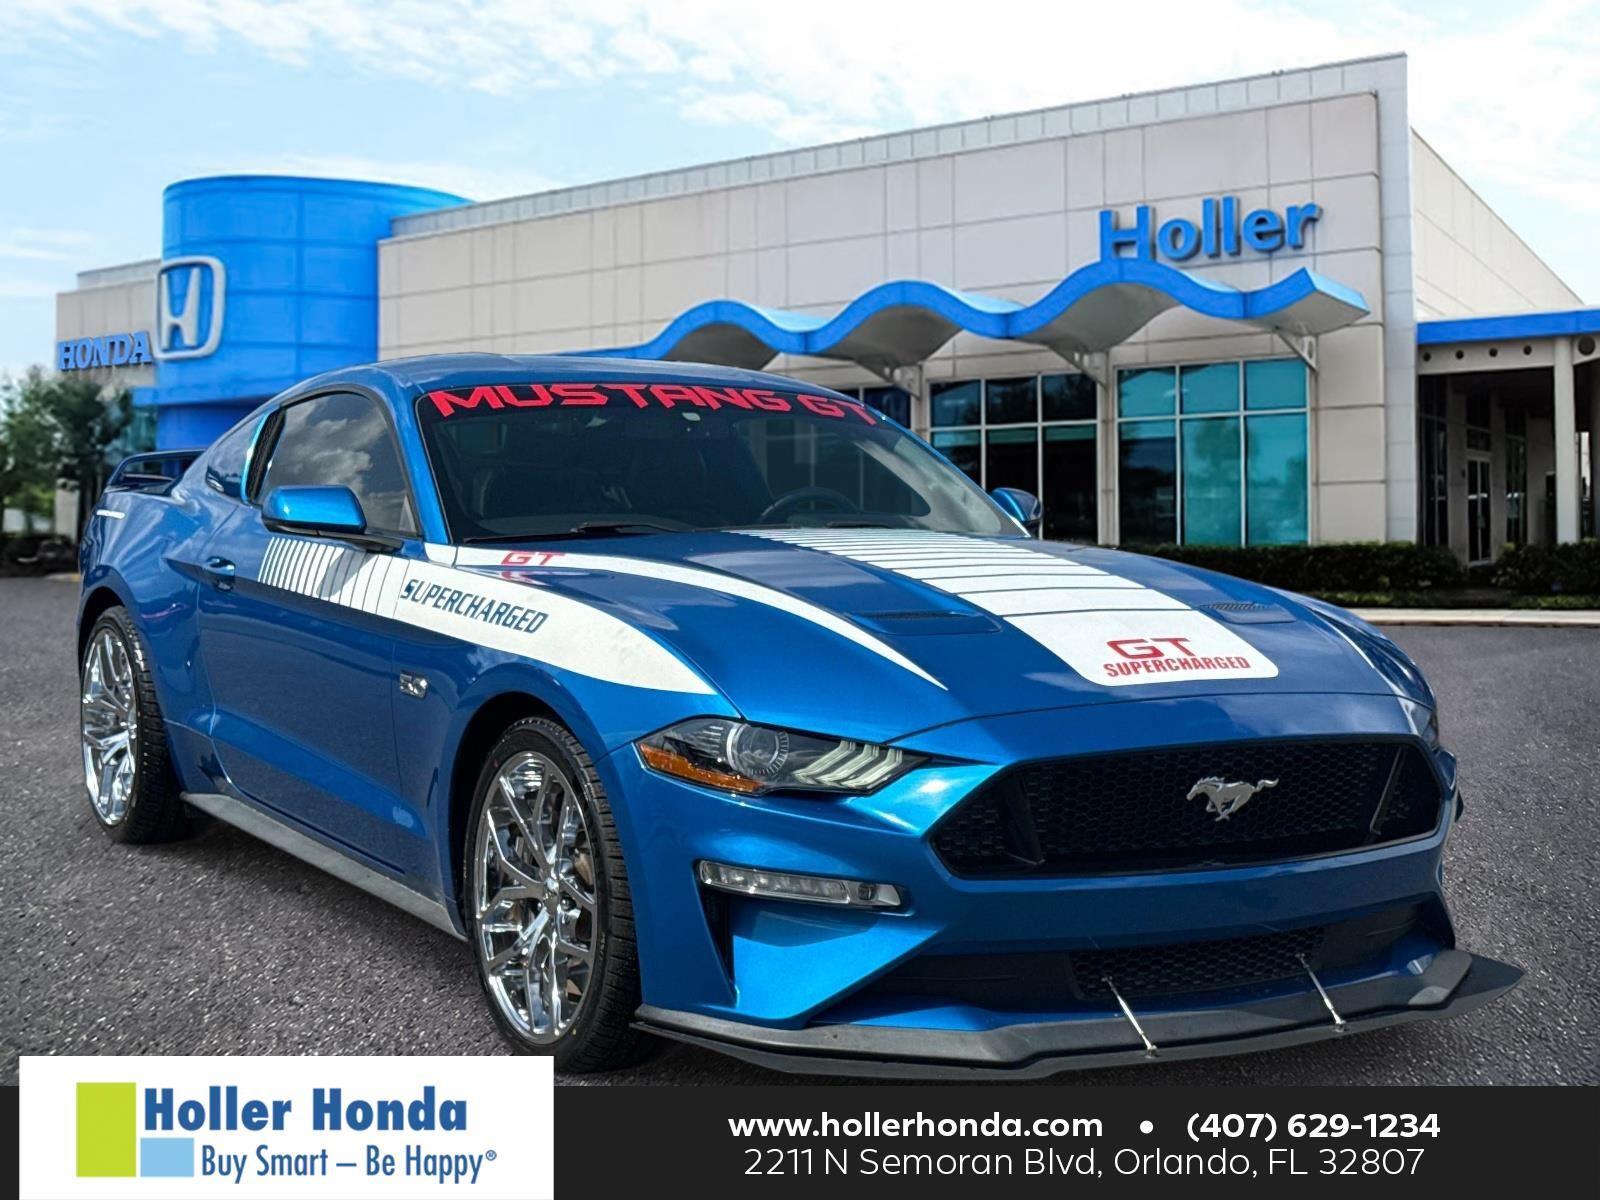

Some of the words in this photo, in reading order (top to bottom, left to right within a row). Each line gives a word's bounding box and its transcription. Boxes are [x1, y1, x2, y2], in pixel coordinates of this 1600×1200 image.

[1099, 195, 1323, 262] Holler
[57, 330, 153, 371] HONDA
[428, 383, 793, 418] MUSTANG
[796, 393, 876, 425] GT
[500, 551, 565, 567] GT
[400, 578, 549, 634] SUPERCHARGED
[1103, 656, 1252, 677] SUPERCHARGED
[1106, 637, 1196, 660] GT
